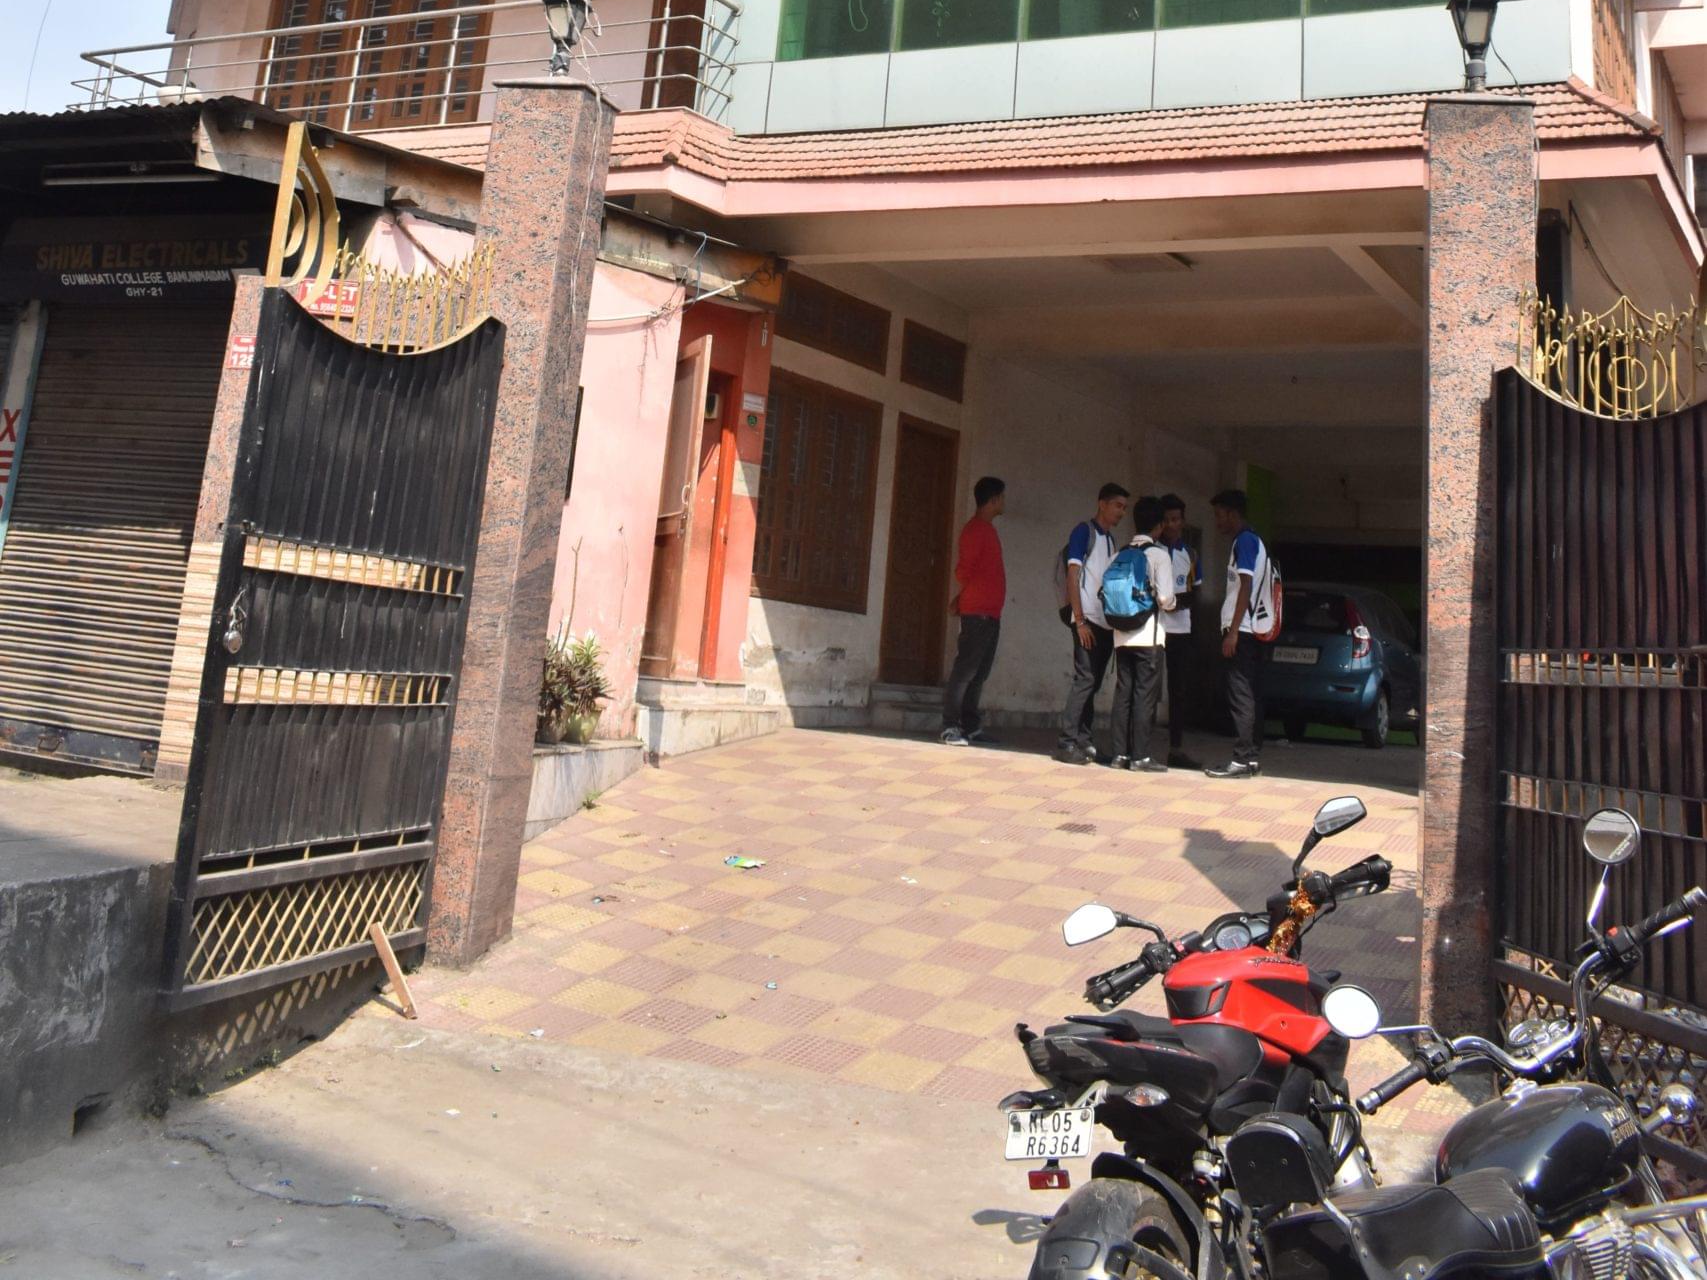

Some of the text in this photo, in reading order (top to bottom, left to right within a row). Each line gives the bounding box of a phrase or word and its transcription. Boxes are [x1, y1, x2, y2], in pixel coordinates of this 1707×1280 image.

[36, 238, 250, 269] SHIVA ELECTRICALS
[60, 272, 115, 286] GUWAHATI
[125, 287, 163, 297] GHY-21
[1052, 1112, 1072, 1133] 05
[1026, 1135, 1081, 1156] R6364
